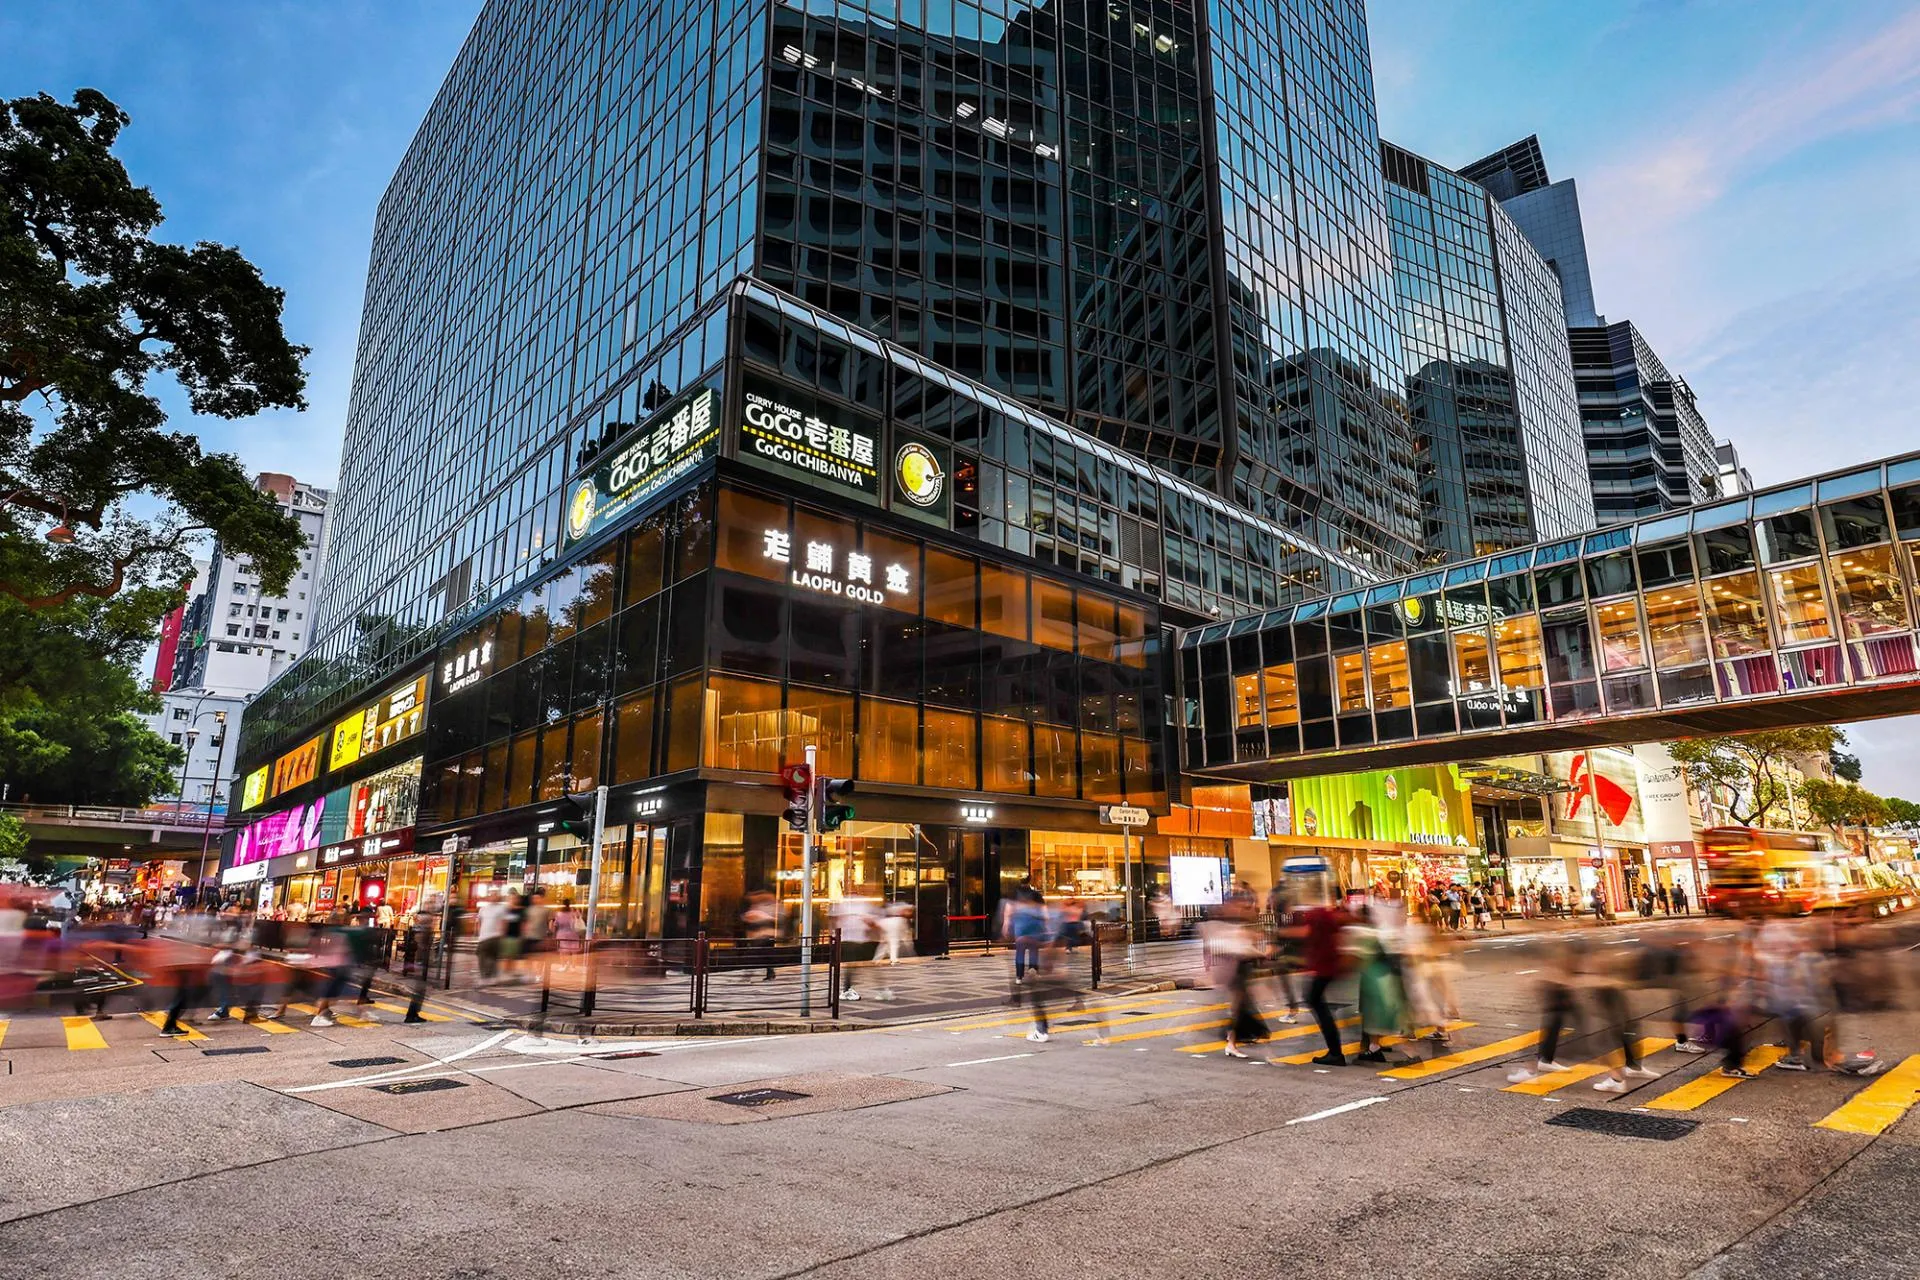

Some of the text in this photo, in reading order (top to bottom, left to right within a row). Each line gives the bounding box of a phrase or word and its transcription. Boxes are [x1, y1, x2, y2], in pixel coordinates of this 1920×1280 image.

[746, 393, 802, 420] CURRY HOUSE
[611, 434, 650, 469] CURRY HOUSE
[792, 570, 884, 604] LAOPU GOLD
